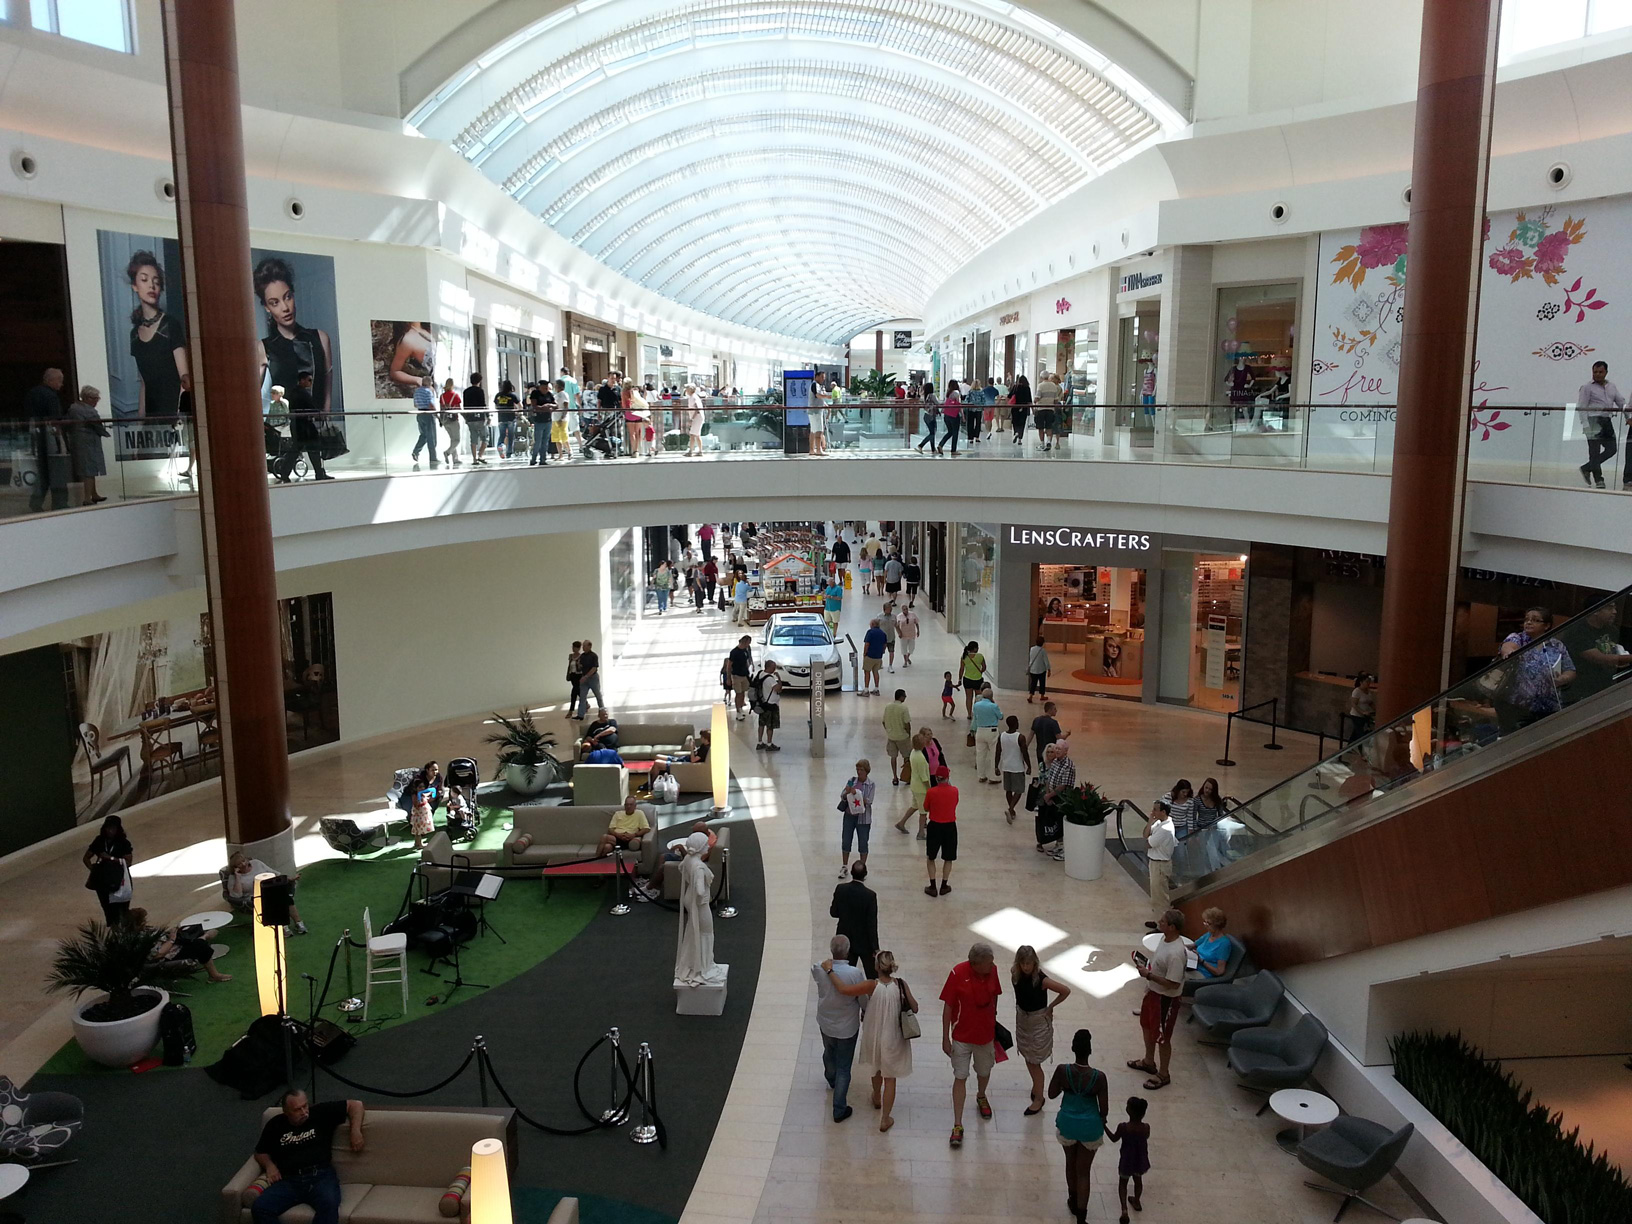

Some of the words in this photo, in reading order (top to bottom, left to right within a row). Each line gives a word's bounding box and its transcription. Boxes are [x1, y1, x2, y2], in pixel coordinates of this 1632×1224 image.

[1319, 370, 1391, 404] free
[1340, 410, 1397, 422] COMING
[1010, 526, 1150, 550] LENSCRAFTERS
[814, 671, 822, 718] DIRECTORY
[280, 1128, 315, 1142] Indian
